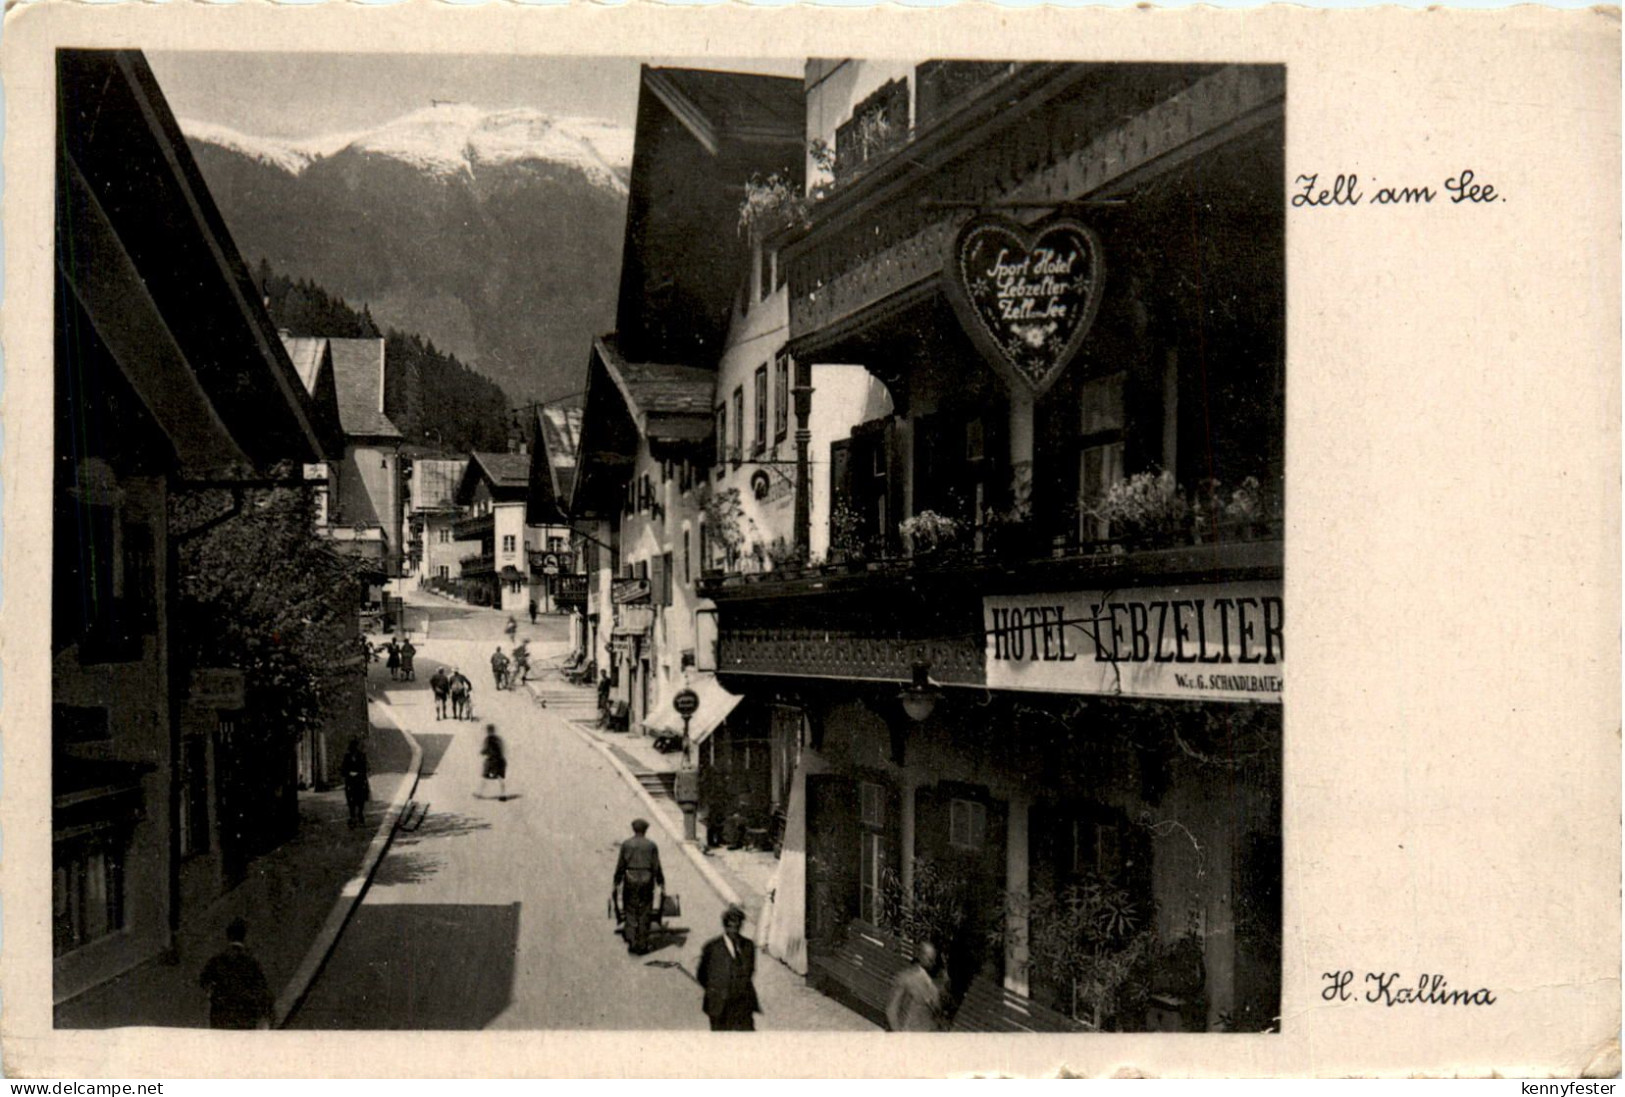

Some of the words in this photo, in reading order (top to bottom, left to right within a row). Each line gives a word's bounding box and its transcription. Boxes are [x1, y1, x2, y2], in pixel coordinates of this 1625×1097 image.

[1291, 173, 1363, 207] Zell
[1370, 186, 1437, 204] am
[1444, 169, 1507, 203] See.
[987, 249, 1030, 277] Sport
[1034, 249, 1076, 274] Hotel
[997, 276, 1068, 298] Lebzelter
[999, 298, 1035, 320] Zell
[992, 606, 1077, 662] HOTEL
[1090, 597, 1284, 664] LEBZELTER
[1321, 970, 1358, 1002] H.
[1365, 972, 1497, 1007] Kallina
